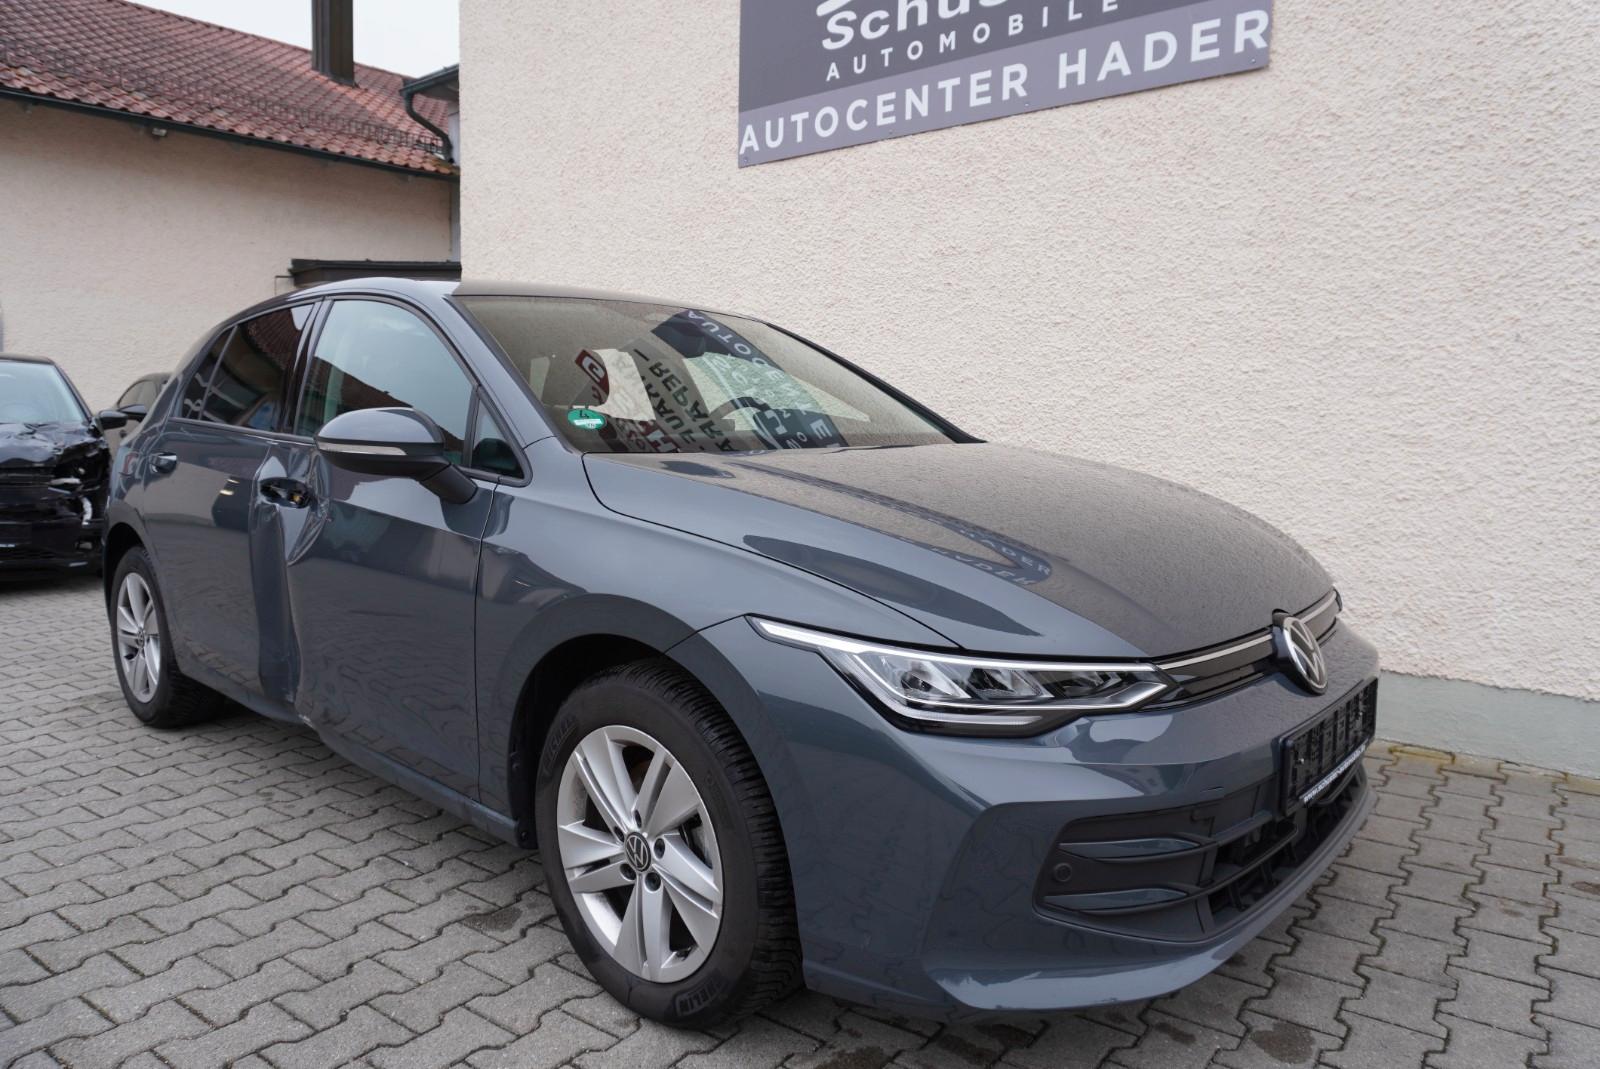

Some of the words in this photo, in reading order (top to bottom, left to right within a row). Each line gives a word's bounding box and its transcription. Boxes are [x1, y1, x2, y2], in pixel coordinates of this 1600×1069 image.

[821, 0, 1008, 50] Schu
[825, 0, 1119, 82] AUTOMOBILE
[739, 62, 1029, 154] AUTOCENTER
[1057, 10, 1269, 89] HADER
